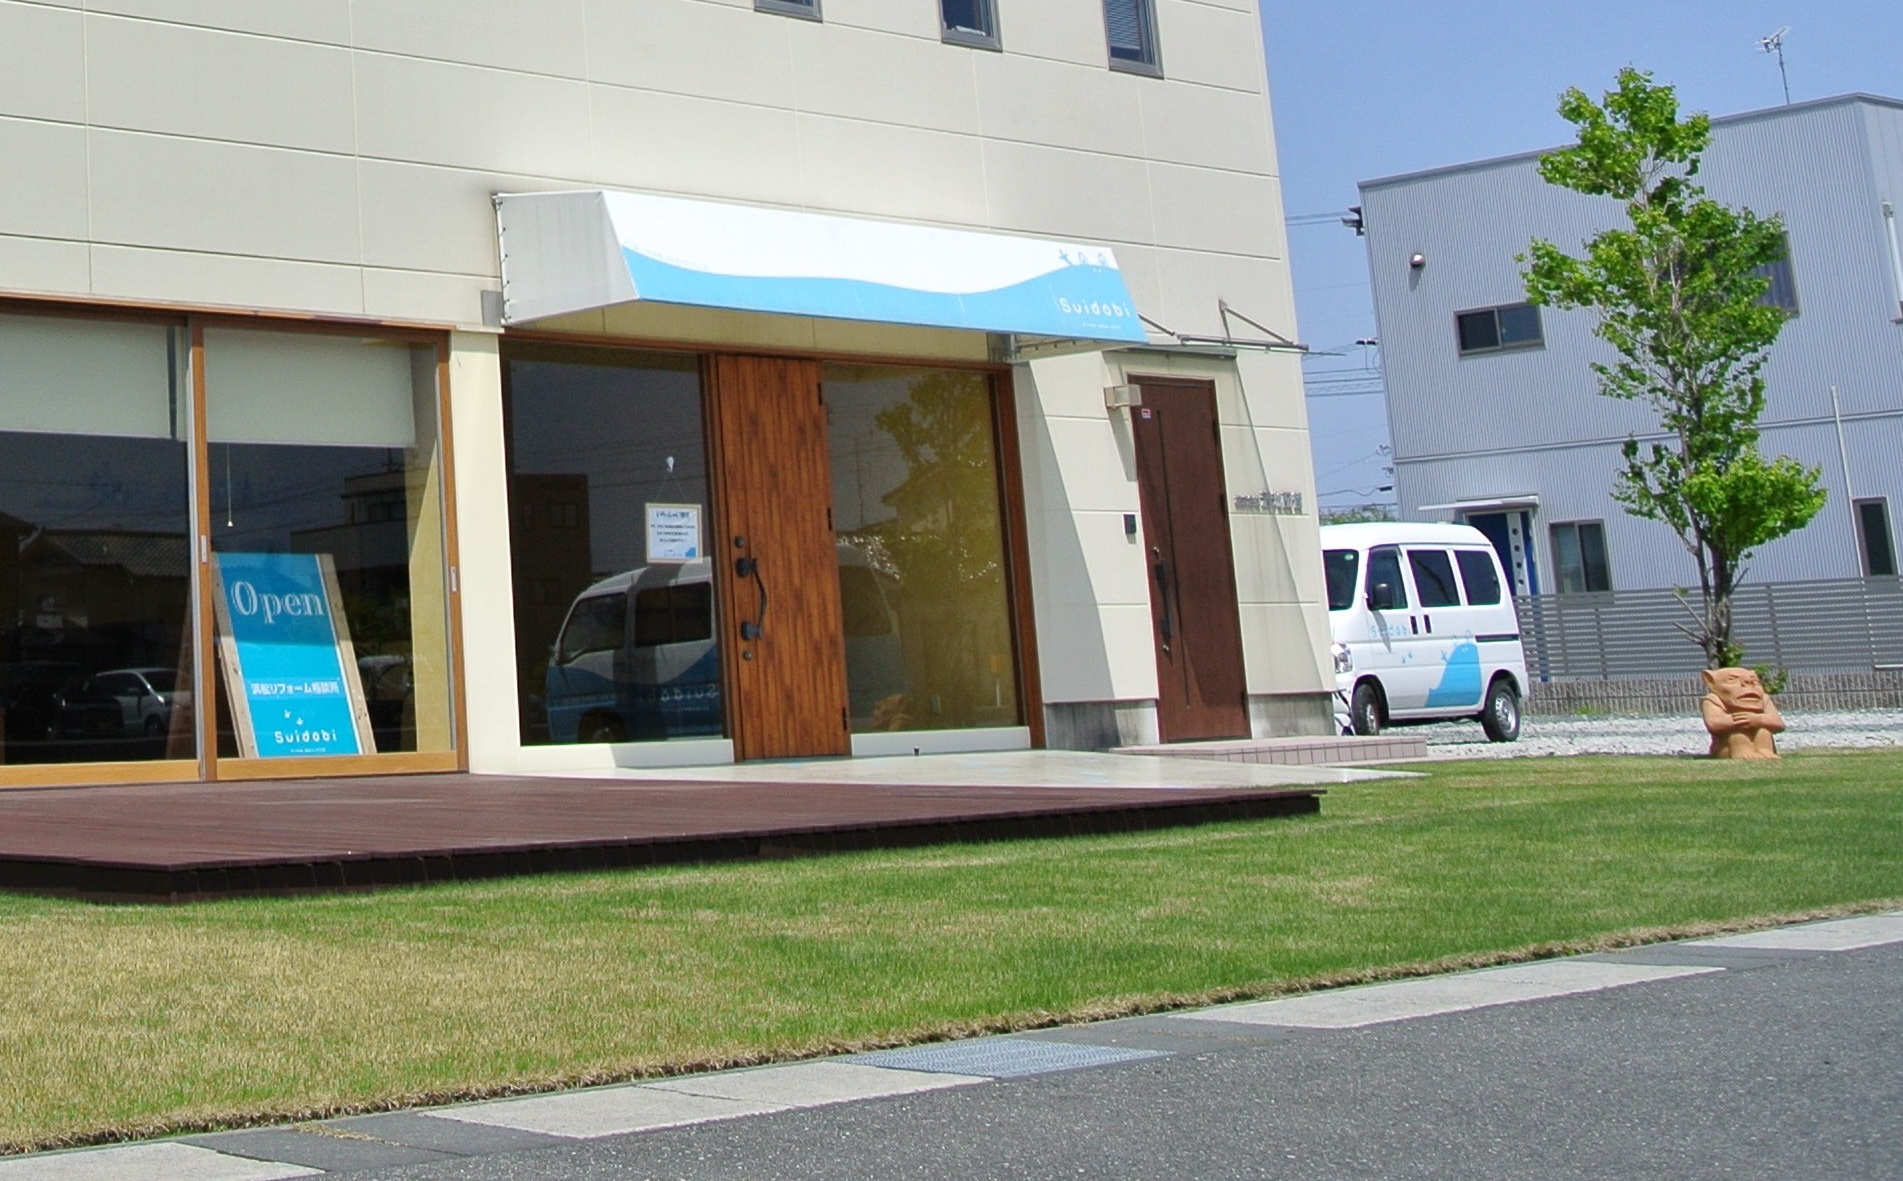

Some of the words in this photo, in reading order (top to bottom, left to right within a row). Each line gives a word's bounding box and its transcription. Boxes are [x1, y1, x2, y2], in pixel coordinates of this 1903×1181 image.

[1059, 297, 1130, 317] Suidobi
[231, 581, 325, 624] Open
[274, 729, 337, 744] Suidobi
